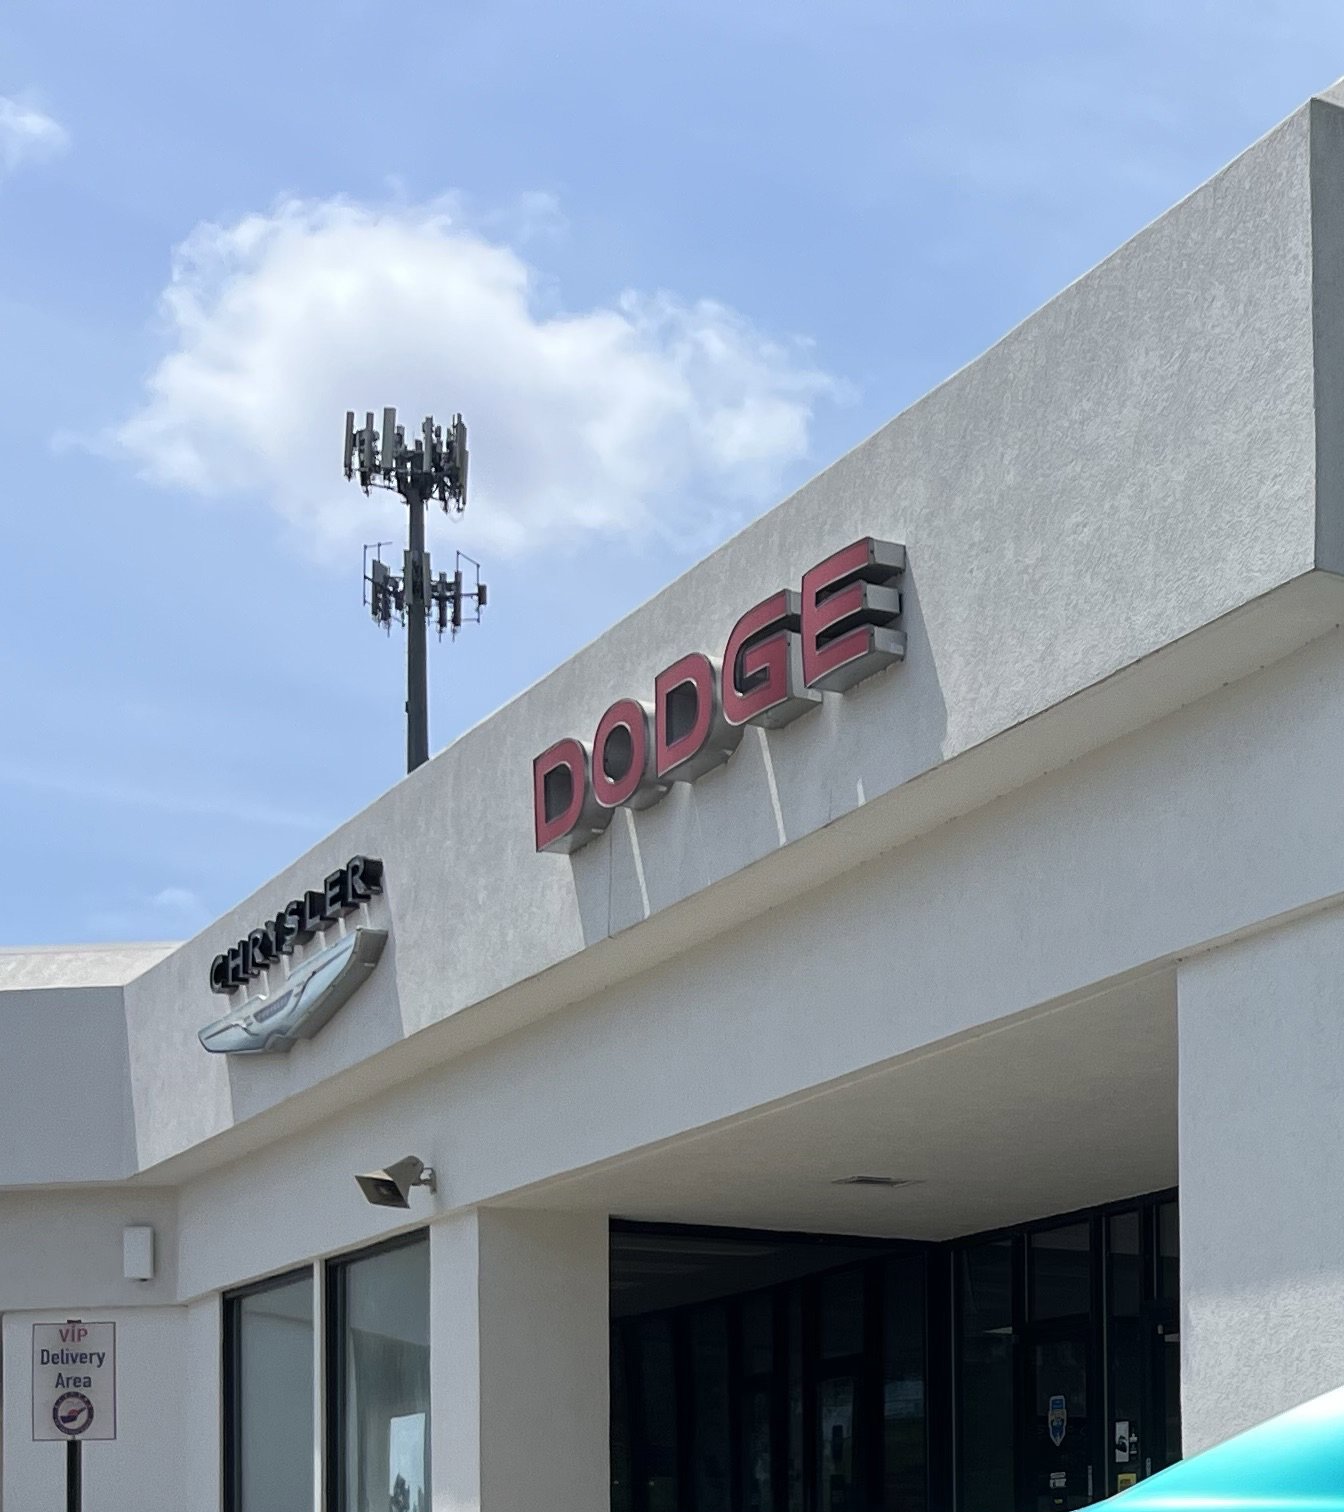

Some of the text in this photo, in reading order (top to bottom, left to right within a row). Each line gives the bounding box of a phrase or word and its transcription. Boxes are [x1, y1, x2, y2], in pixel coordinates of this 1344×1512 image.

[532, 536, 908, 854] DODGE
[209, 854, 384, 995] CHRYSLER
[59, 1326, 88, 1343] VIP
[40, 1348, 106, 1369] Delivery
[55, 1372, 92, 1389] Area
